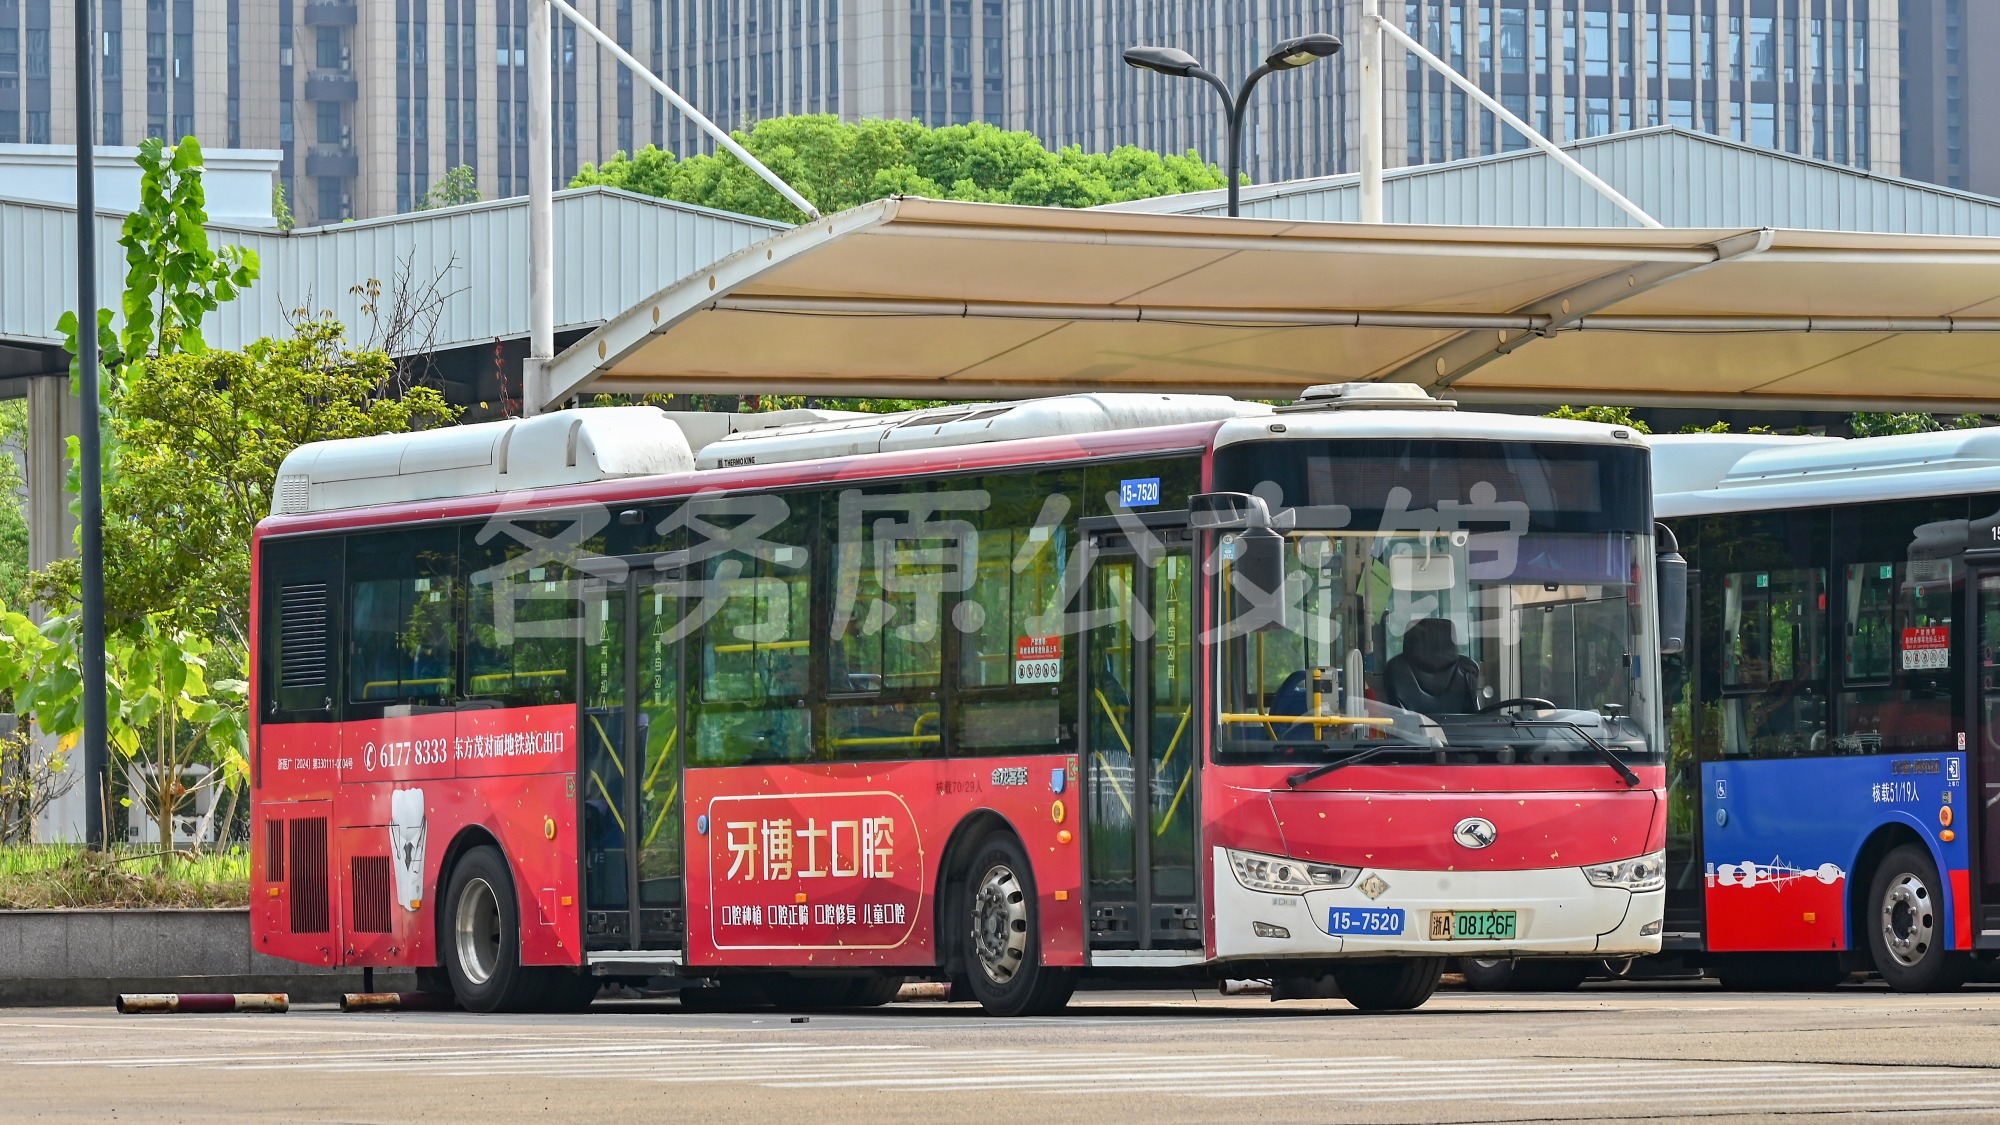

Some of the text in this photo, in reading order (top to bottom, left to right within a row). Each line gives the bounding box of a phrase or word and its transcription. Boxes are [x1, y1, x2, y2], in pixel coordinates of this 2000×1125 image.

[1122, 482, 1158, 503] 15-7520
[379, 731, 564, 768] 6177 8333 东方茂对面地铁站C出口
[936, 780, 983, 795] 核载70/29人
[1872, 781, 1920, 803] 核载51/19人
[726, 815, 894, 881] 牙博士口腔
[722, 903, 906, 926] 口腔种植 口腔正畸 口腔修复 儿童口腔
[1332, 911, 1400, 932] 15-7520
